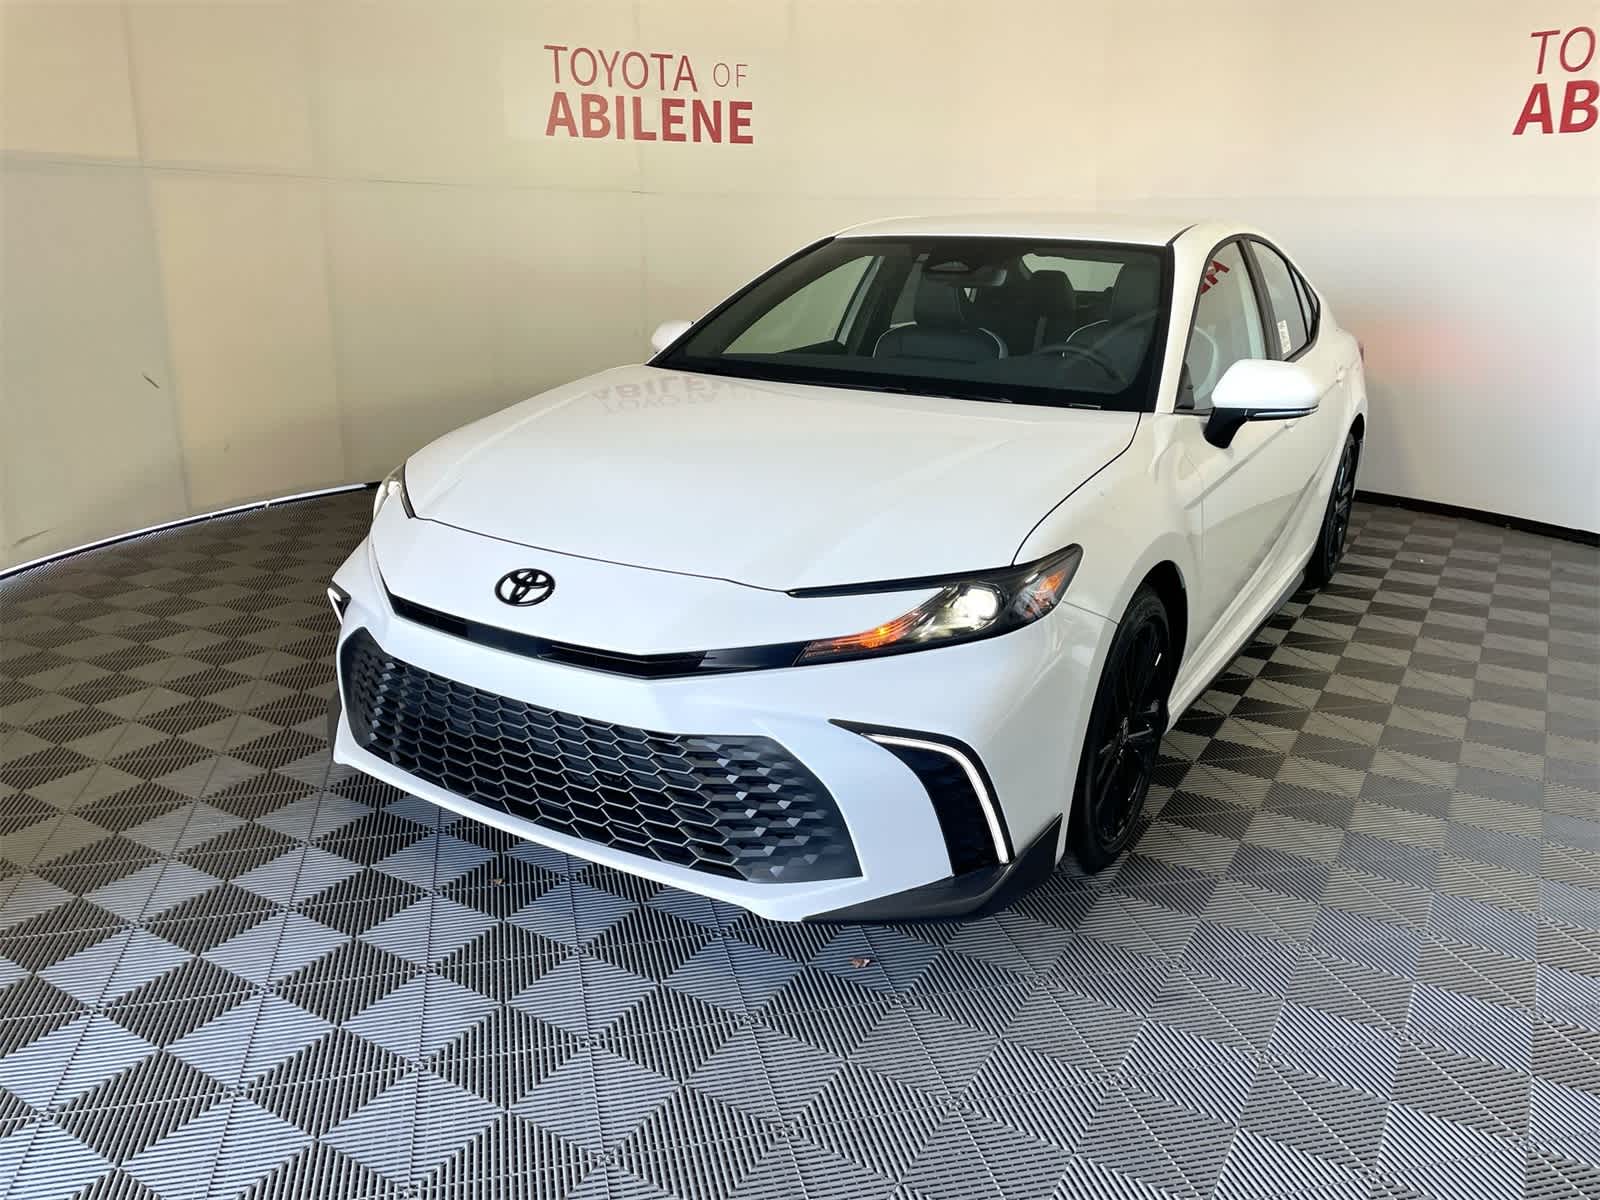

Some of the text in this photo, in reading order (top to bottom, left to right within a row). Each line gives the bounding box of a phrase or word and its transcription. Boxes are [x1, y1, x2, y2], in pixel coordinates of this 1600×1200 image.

[544, 44, 748, 92] TOYOTA OF
[545, 91, 754, 144] ABILENE
